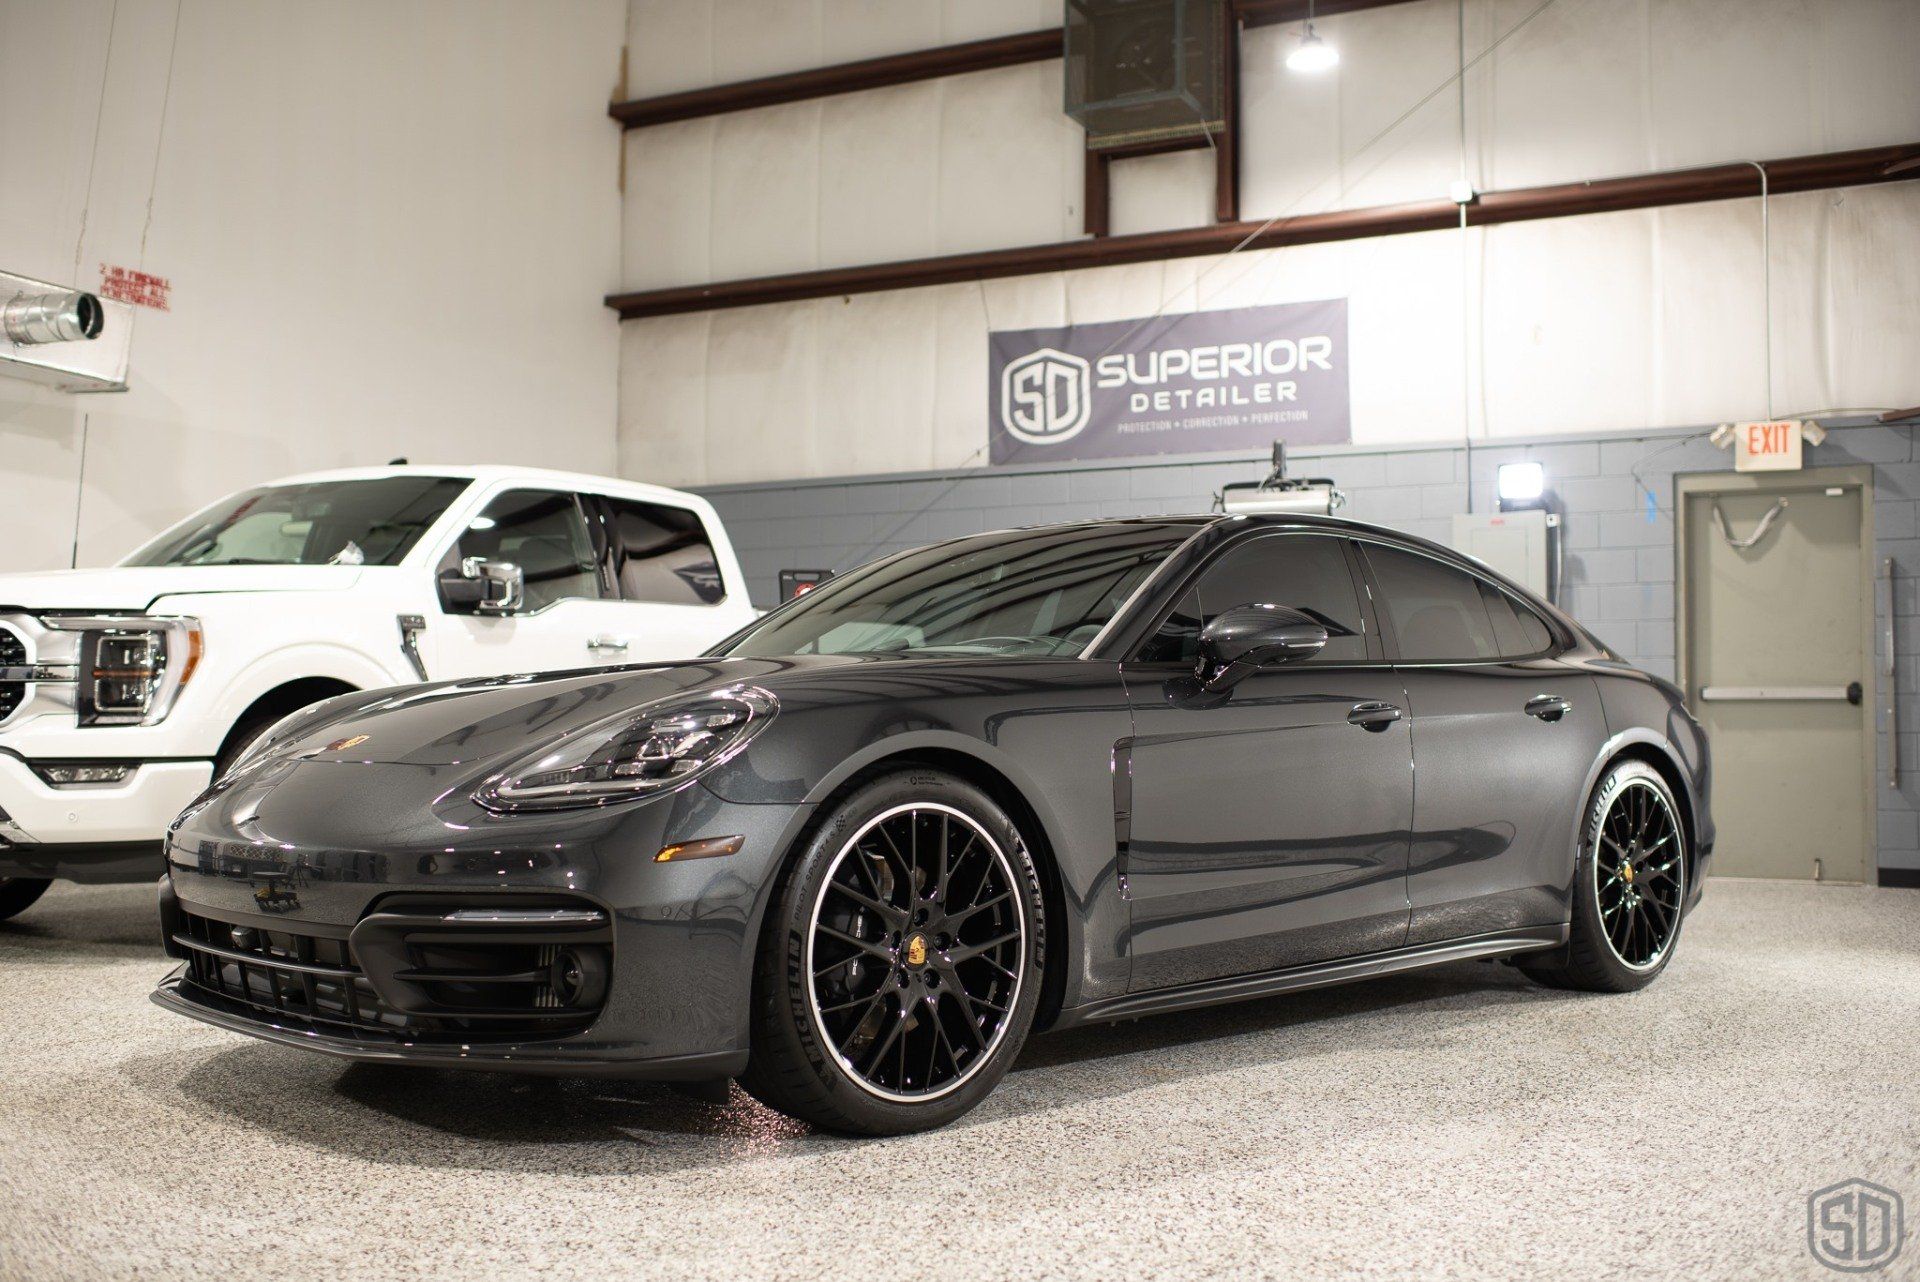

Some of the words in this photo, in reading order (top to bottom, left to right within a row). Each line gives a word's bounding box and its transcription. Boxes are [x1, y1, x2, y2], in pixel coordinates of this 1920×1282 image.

[1097, 335, 1333, 388] SUPERIOR
[1012, 360, 1079, 433] SD
[1117, 421, 1172, 434] PROTECTION
[1182, 414, 1240, 430] CORRECTION
[1250, 409, 1309, 424] PERFECTION
[1130, 380, 1298, 413] DETAILER
[1748, 423, 1791, 455] EXIT
[1018, 850, 1045, 962] MICHELIN
[788, 938, 822, 1064] MICHELIN
